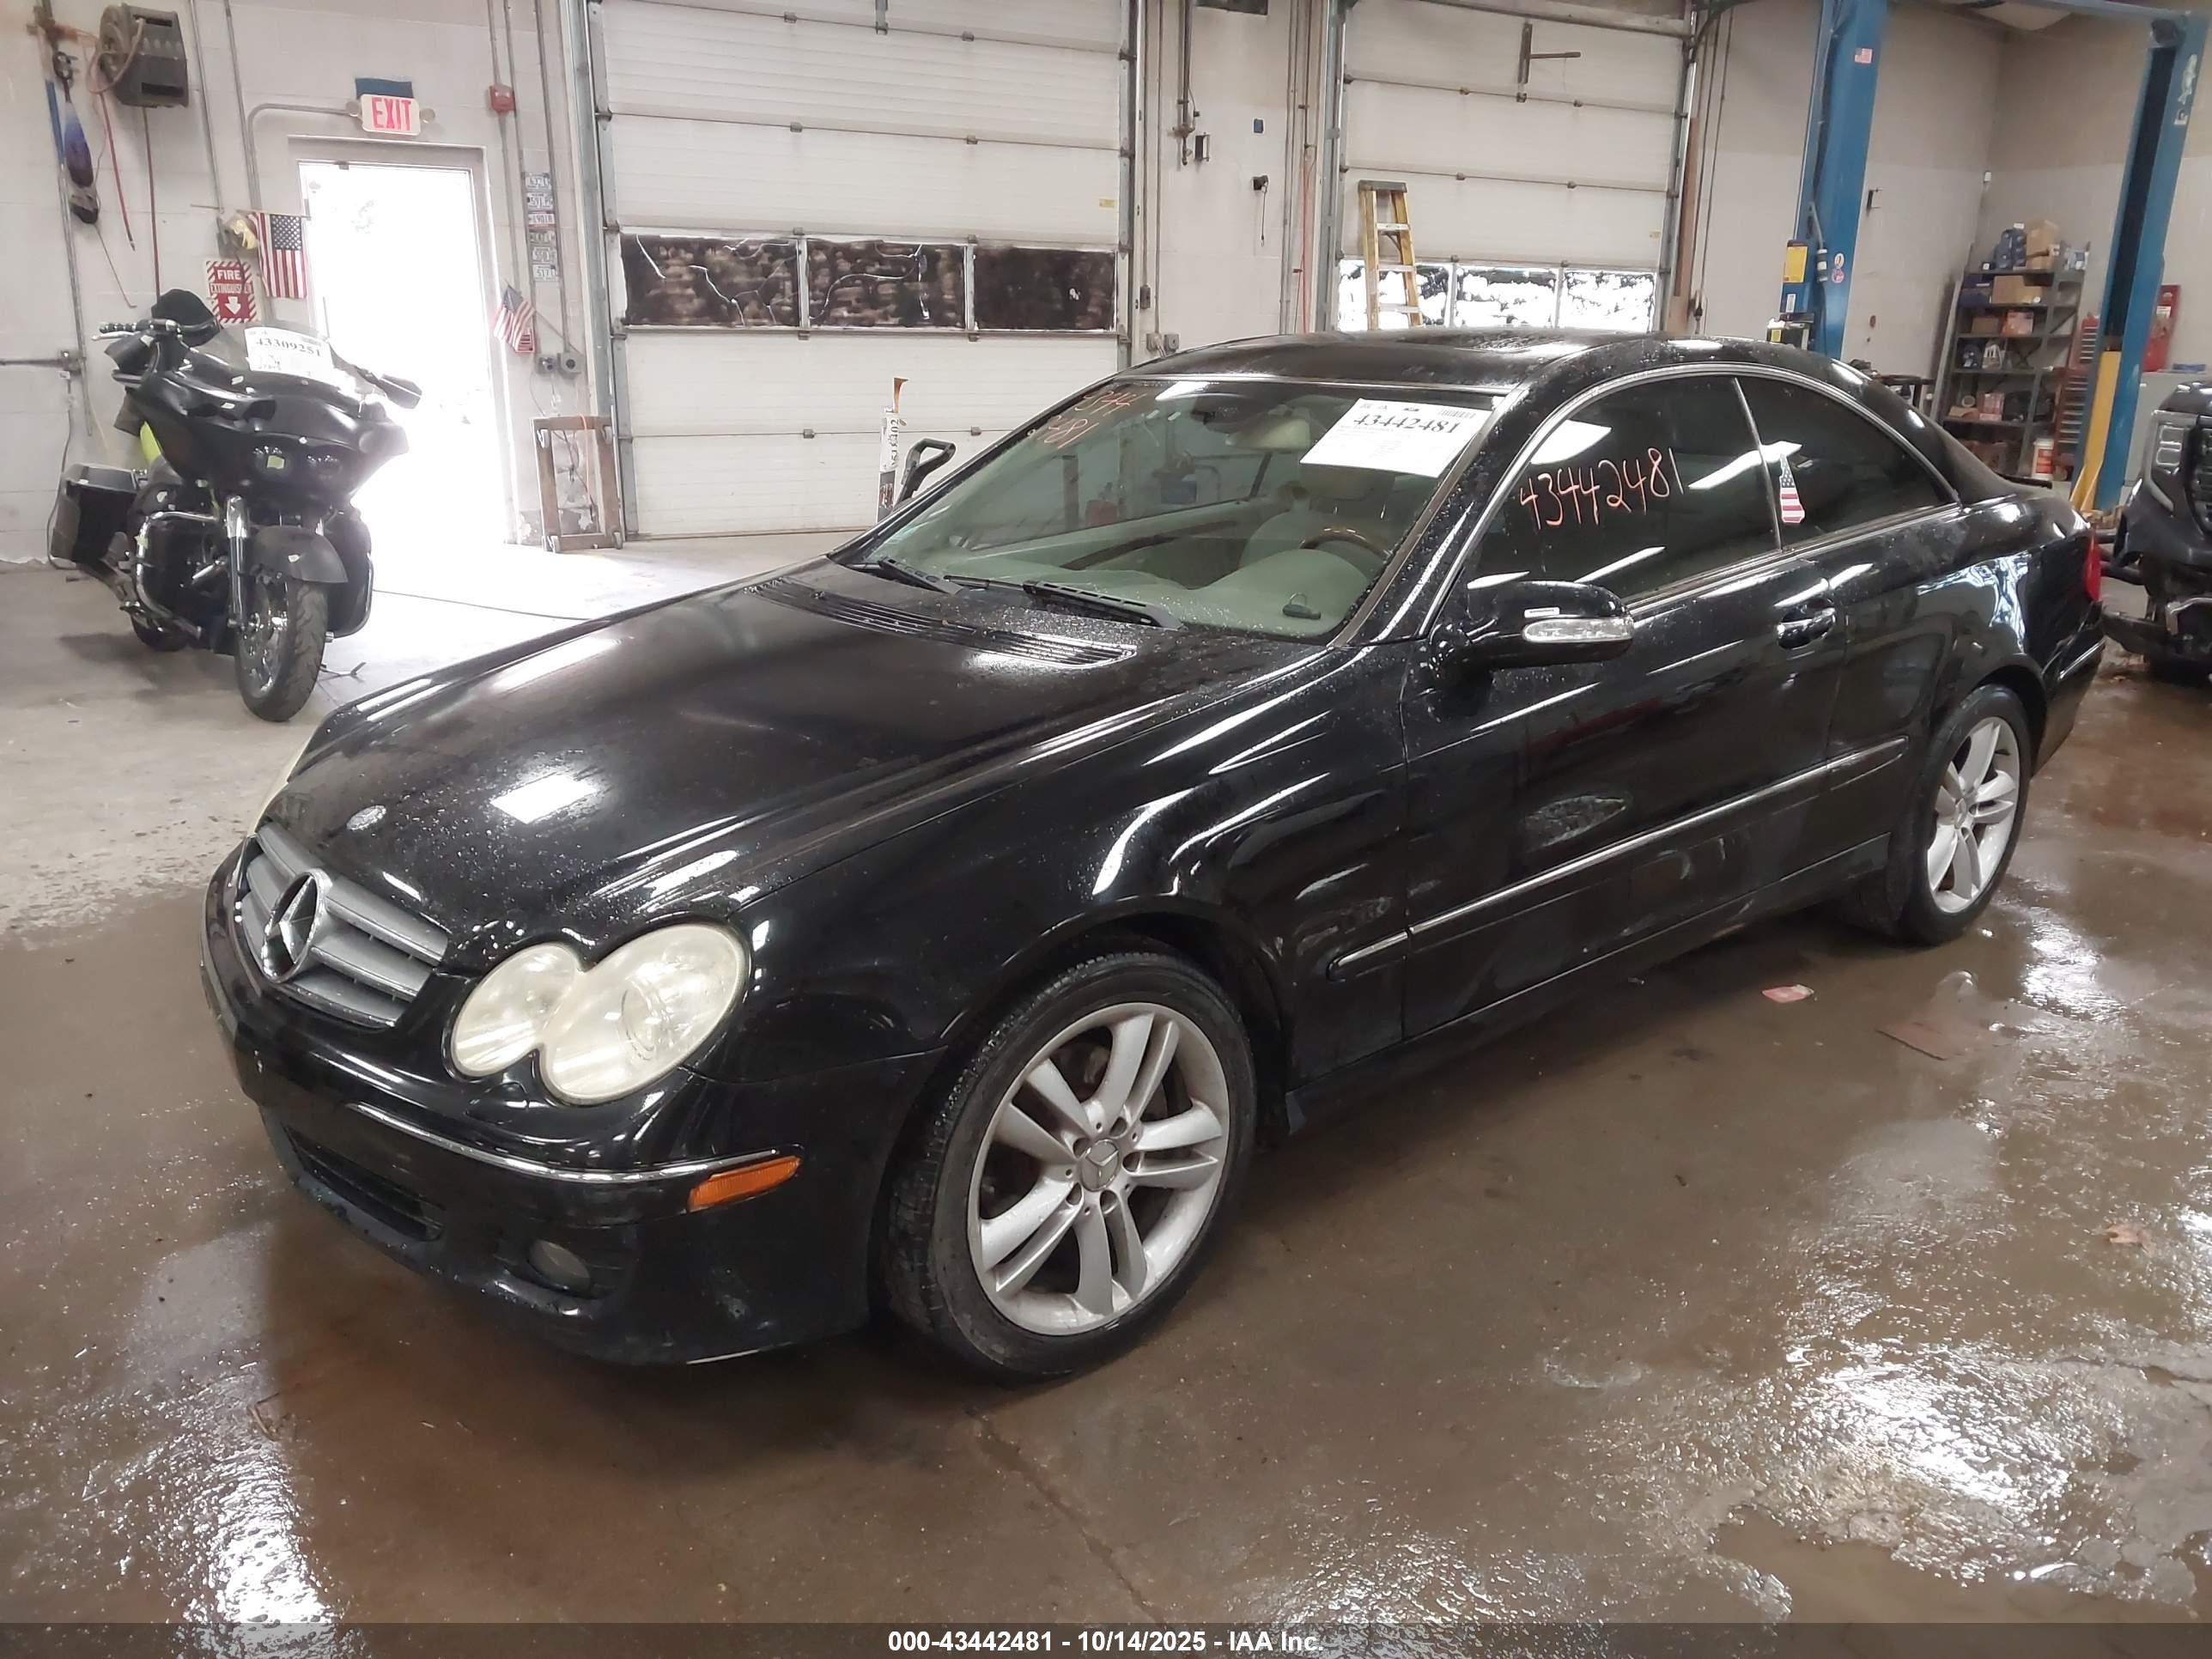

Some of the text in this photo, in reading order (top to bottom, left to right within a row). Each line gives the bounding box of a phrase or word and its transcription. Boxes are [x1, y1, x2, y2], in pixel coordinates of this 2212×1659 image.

[372, 96, 411, 131] EXIT
[216, 269, 242, 281] FIRE
[255, 337, 321, 357] 43309251
[1352, 413, 1461, 434] 43442481
[1519, 447, 1685, 530] 43442481
